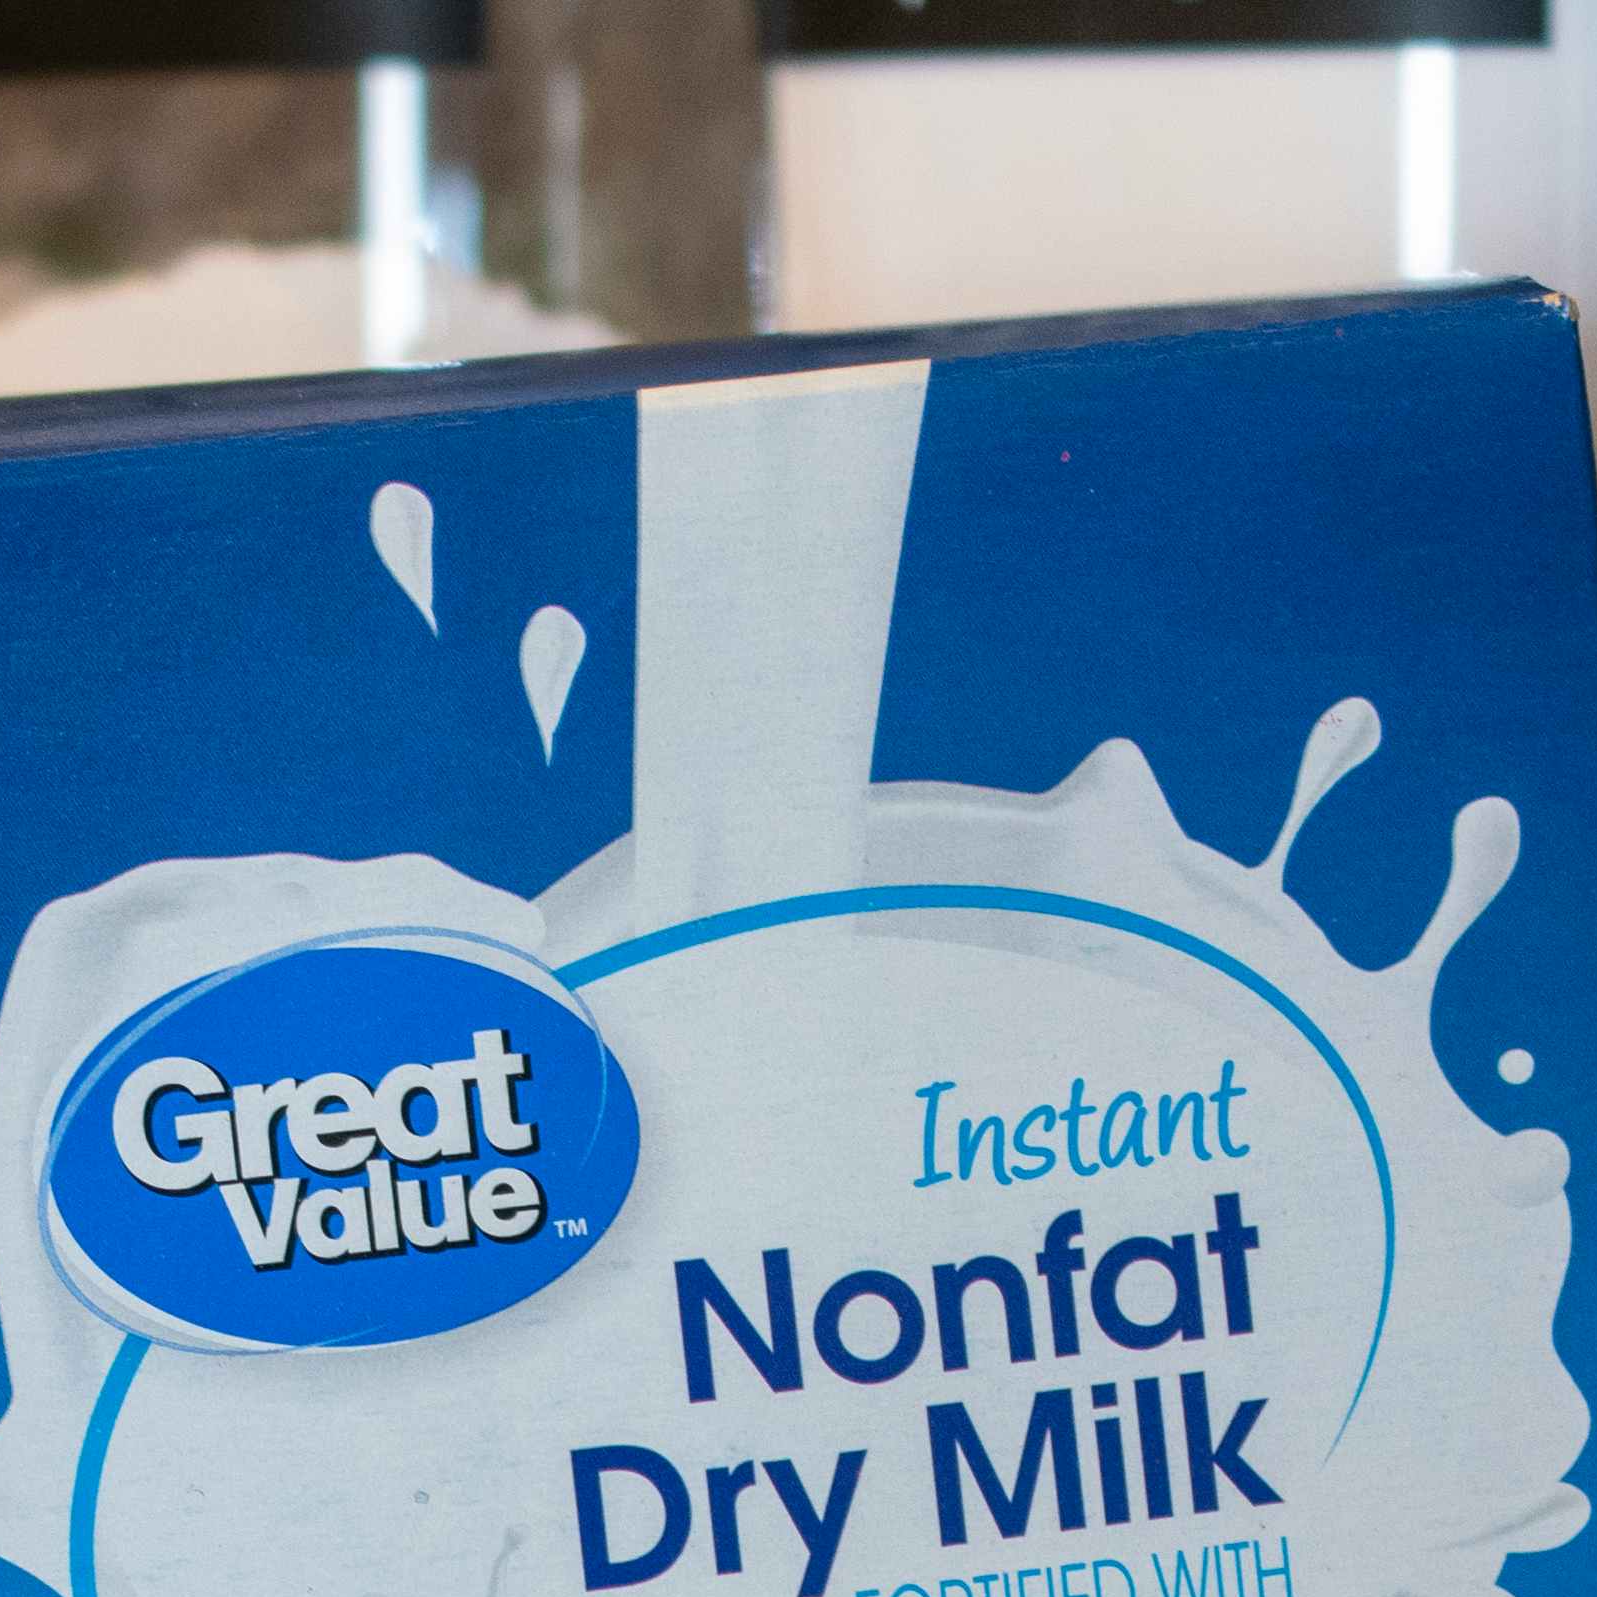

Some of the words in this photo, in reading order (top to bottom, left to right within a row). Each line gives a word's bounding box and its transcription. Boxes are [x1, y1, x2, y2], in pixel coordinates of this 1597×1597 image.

[112, 1028, 535, 1193] Great
[914, 1061, 1250, 1189] Instant
[219, 1160, 543, 1268] Value
[672, 1191, 1258, 1404] Nonfat
[928, 1372, 1283, 1547] Milk
